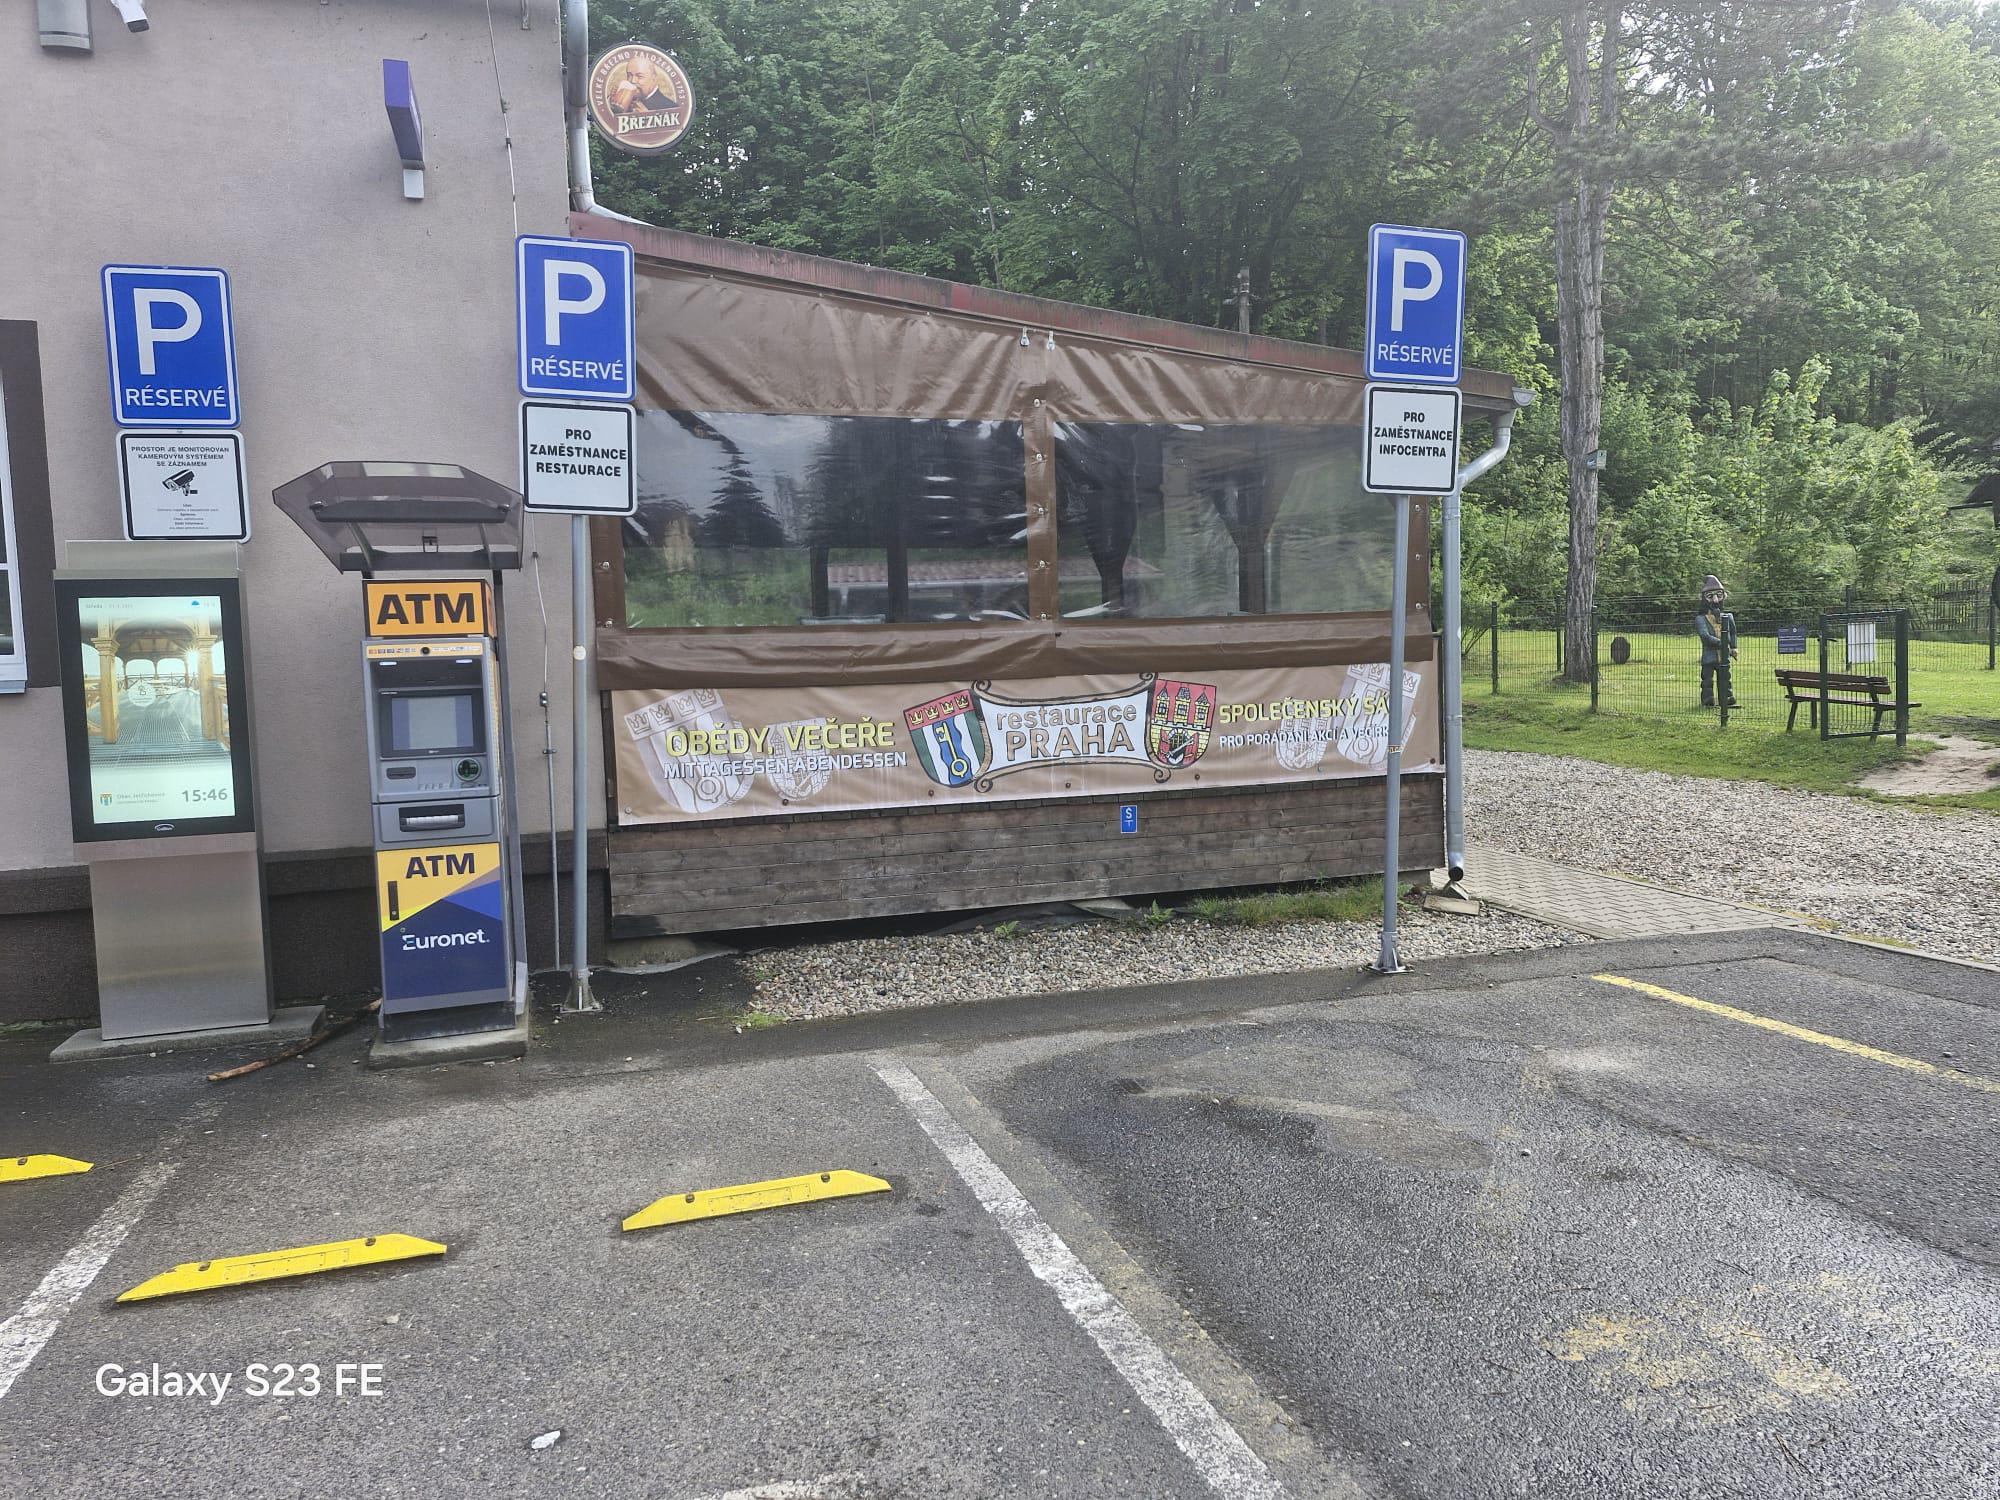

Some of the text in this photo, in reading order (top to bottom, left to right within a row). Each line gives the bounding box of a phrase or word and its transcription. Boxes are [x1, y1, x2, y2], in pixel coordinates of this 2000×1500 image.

[616, 112, 680, 134] BŘEZŇÁK
[543, 259, 606, 346] P
[1390, 248, 1443, 332] P
[133, 287, 202, 375] P
[1377, 340, 1453, 365] RÉSERVÉ
[531, 355, 624, 381] RÉSERVÉ
[125, 384, 227, 407] RÉSERVÉ
[1403, 411, 1425, 423] PRO
[565, 428, 592, 440] PRO
[1374, 425, 1453, 441] ZAMĚSTNANCE
[529, 443, 627, 460] ZAMĚSTNANCE
[1379, 444, 1447, 457] INFOCENTRA
[536, 461, 622, 477] RESTAURACE
[377, 592, 475, 625] ATM
[996, 704, 1137, 731] restaurace
[1219, 691, 1389, 724] SPOLEČENSKÝ SÁ
[665, 716, 895, 757] OBĚDY, VEČEŘE
[1006, 722, 1135, 761] PRAHA
[1219, 735, 1245, 747] PRO
[1340, 728, 1349, 740] A
[181, 788, 228, 803] 15:46
[405, 853, 475, 879] ATM
